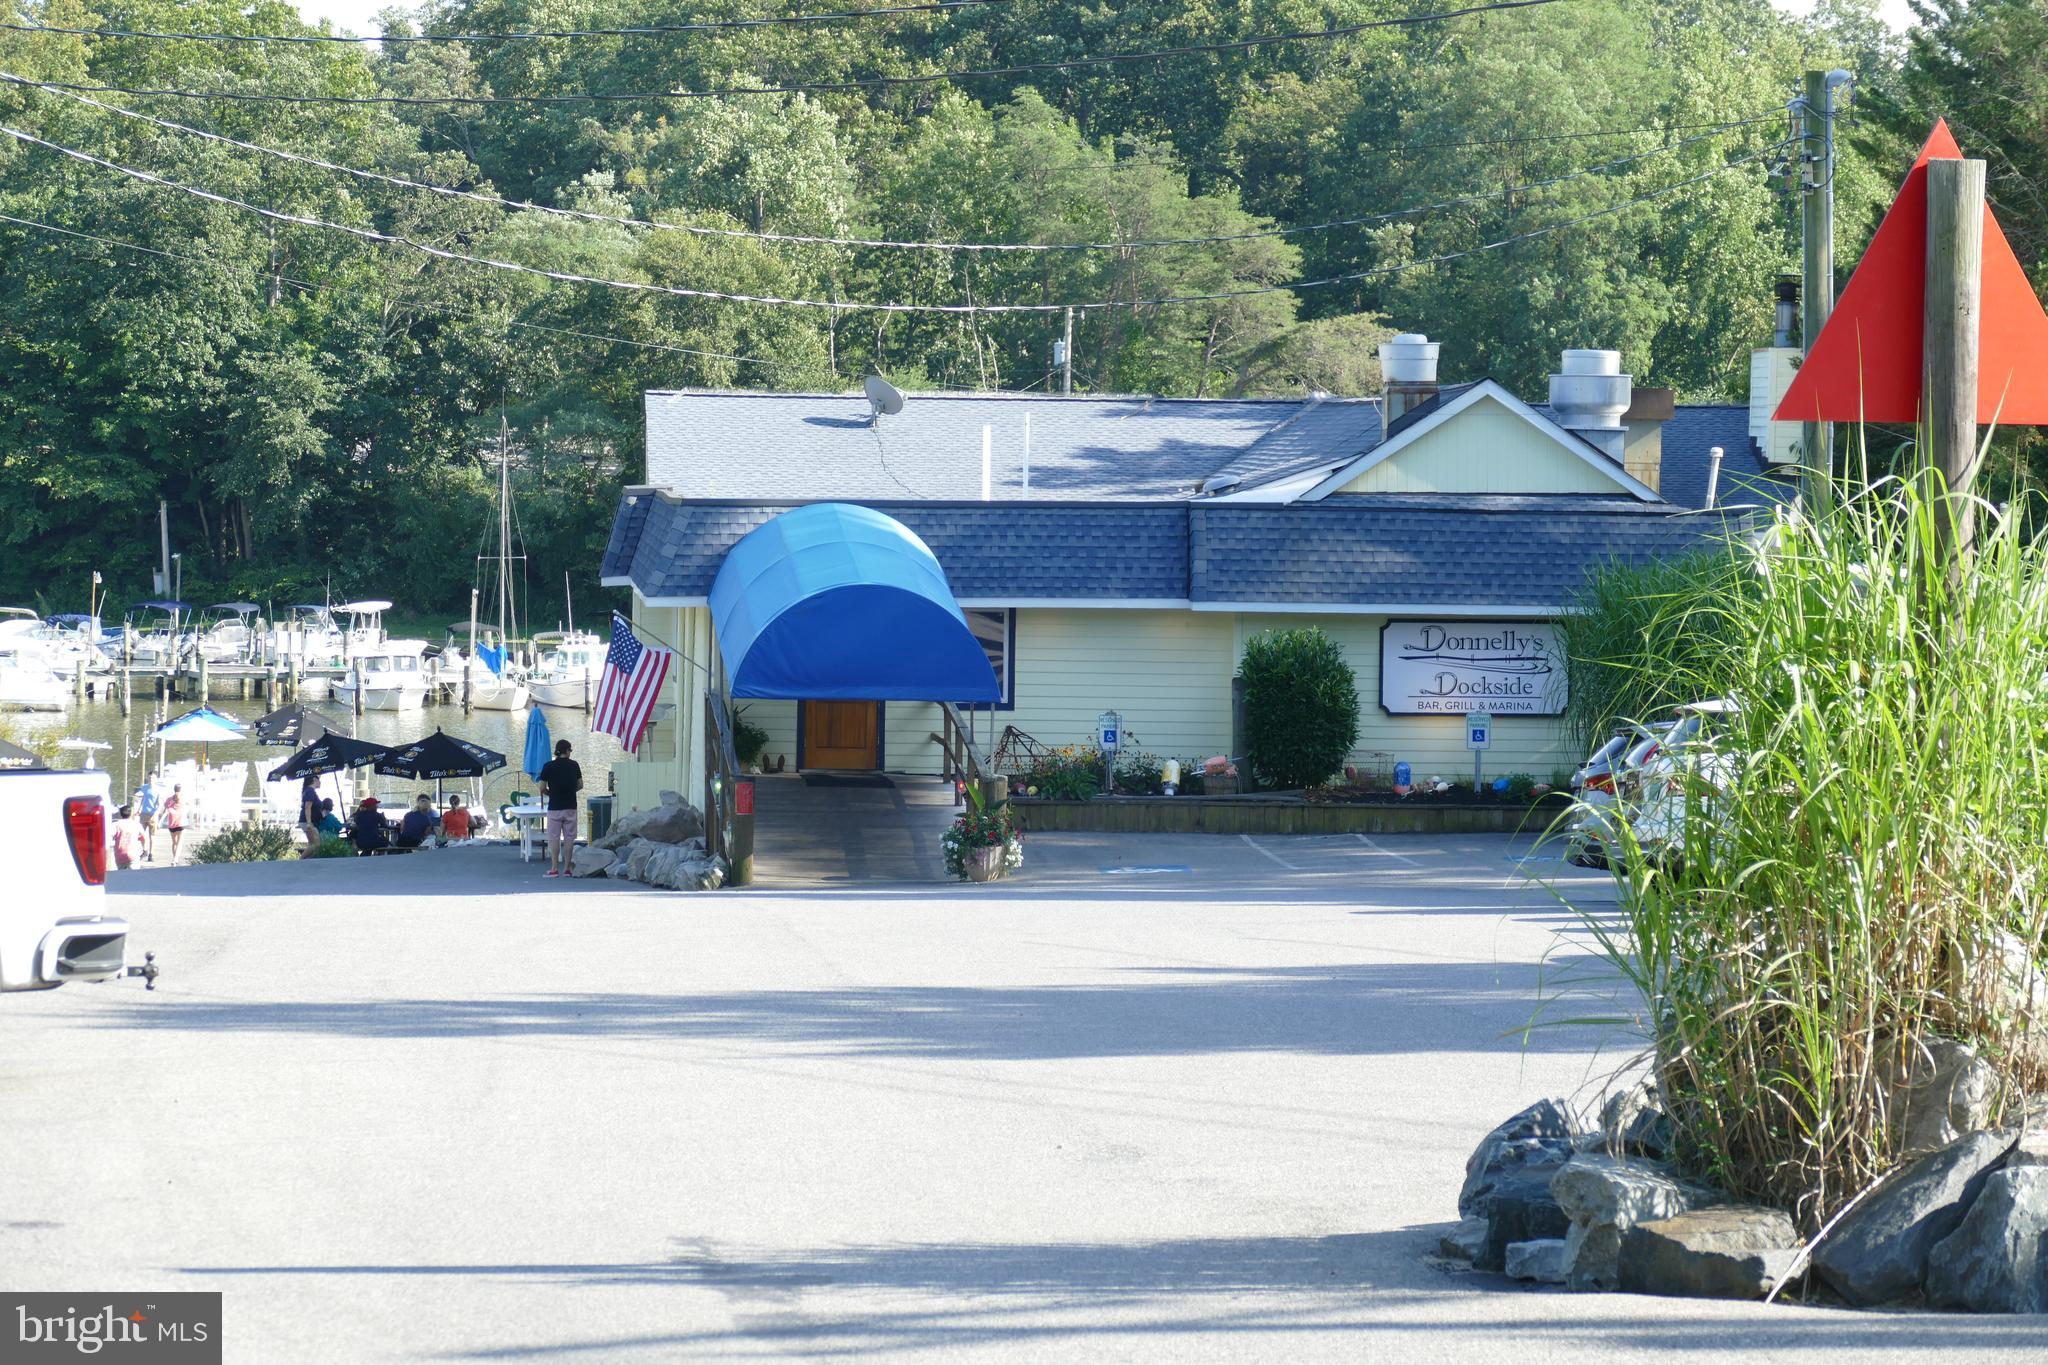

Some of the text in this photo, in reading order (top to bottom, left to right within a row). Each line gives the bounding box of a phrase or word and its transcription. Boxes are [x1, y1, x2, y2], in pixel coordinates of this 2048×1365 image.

[1403, 625, 1543, 656] Donnelly's
[1419, 671, 1533, 695] Dockside
[1417, 701, 1533, 711] BAR, GRILL & MARINA
[430, 770, 448, 778] Tito's
